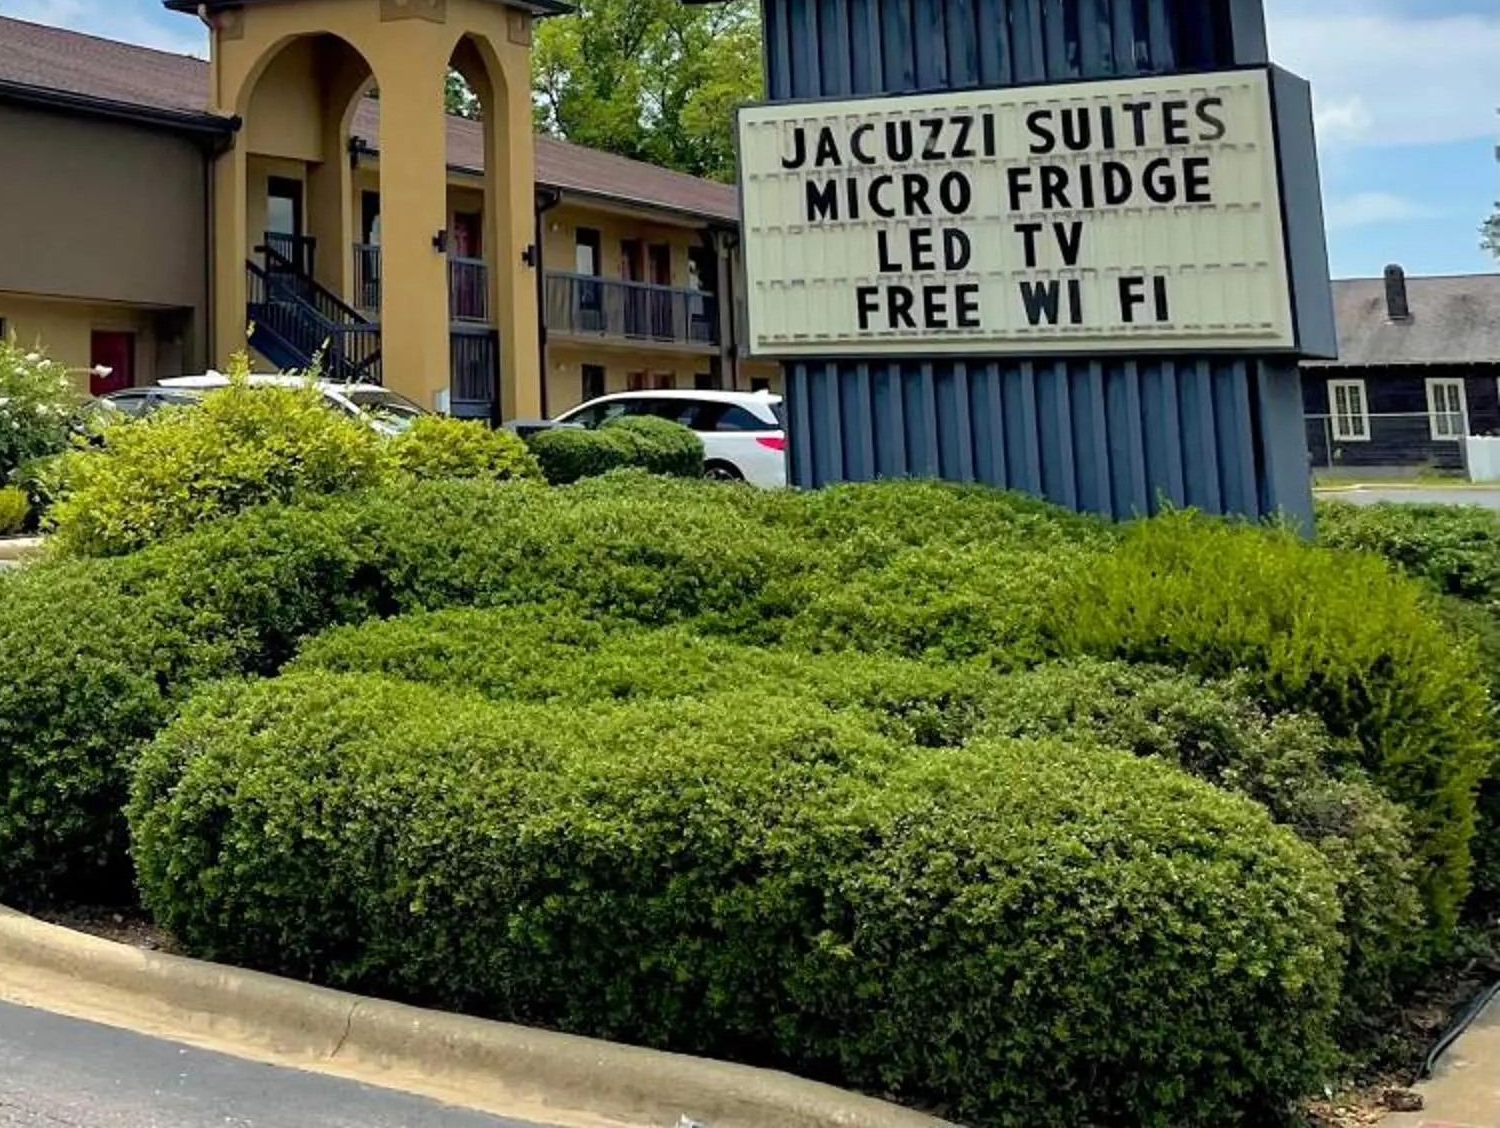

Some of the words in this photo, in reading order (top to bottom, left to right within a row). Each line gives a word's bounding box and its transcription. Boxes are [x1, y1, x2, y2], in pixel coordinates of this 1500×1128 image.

[780, 112, 997, 171] JACUZZI
[1025, 95, 1227, 156] SUITES
[804, 169, 973, 224] MICRO
[1005, 155, 1213, 212] FRIDGE
[876, 226, 972, 274] LED
[1012, 219, 1085, 270] TV
[854, 282, 982, 331] FREE
[1017, 277, 1084, 326] WI
[1116, 274, 1170, 323] FI
